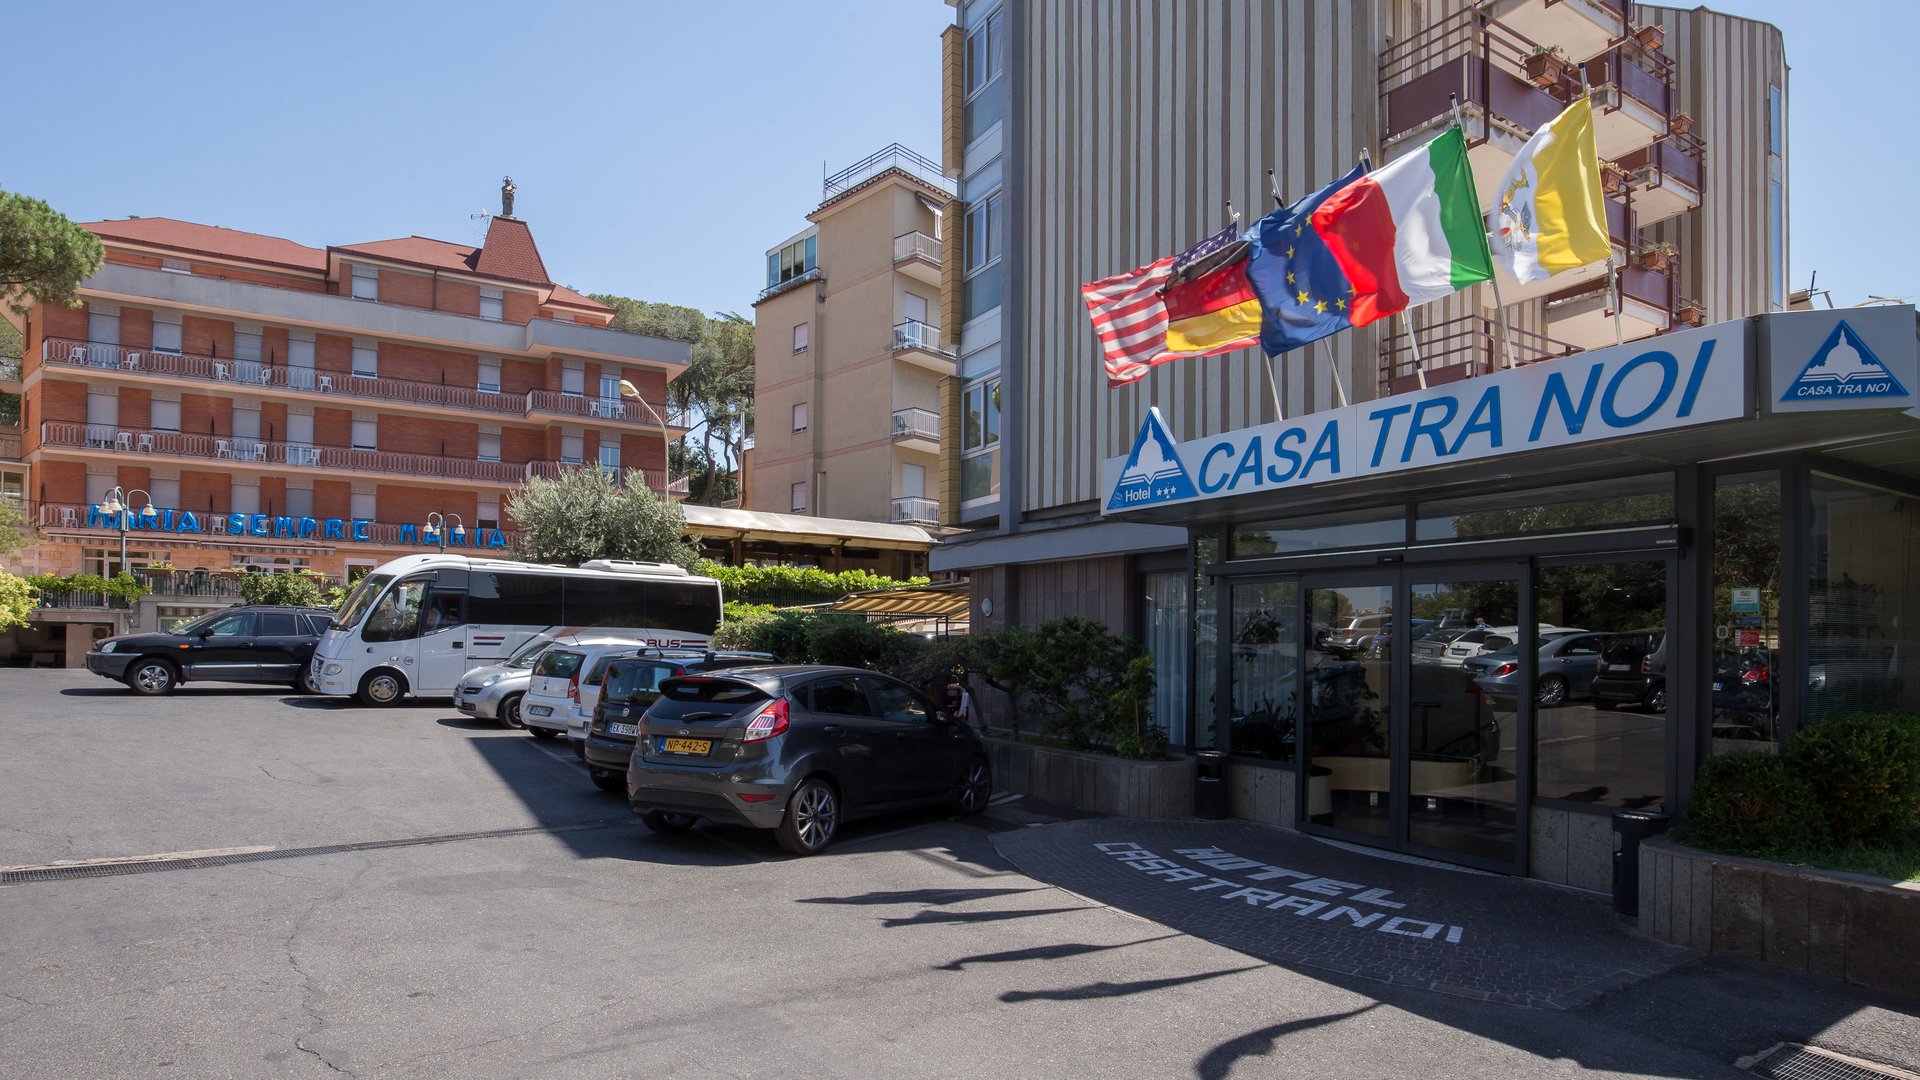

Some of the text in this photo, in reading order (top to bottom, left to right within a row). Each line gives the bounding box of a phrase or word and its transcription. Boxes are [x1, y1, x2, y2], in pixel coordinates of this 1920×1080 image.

[1797, 383, 1891, 396] CASA TRA NOI
[1198, 338, 1717, 494] CASA TRA NOI
[1125, 486, 1151, 502] Hotel
[88, 504, 507, 548] MARIA SEMPRE MARIA
[666, 740, 708, 752] NP-442-S
[1172, 848, 1407, 909] HOTEL
